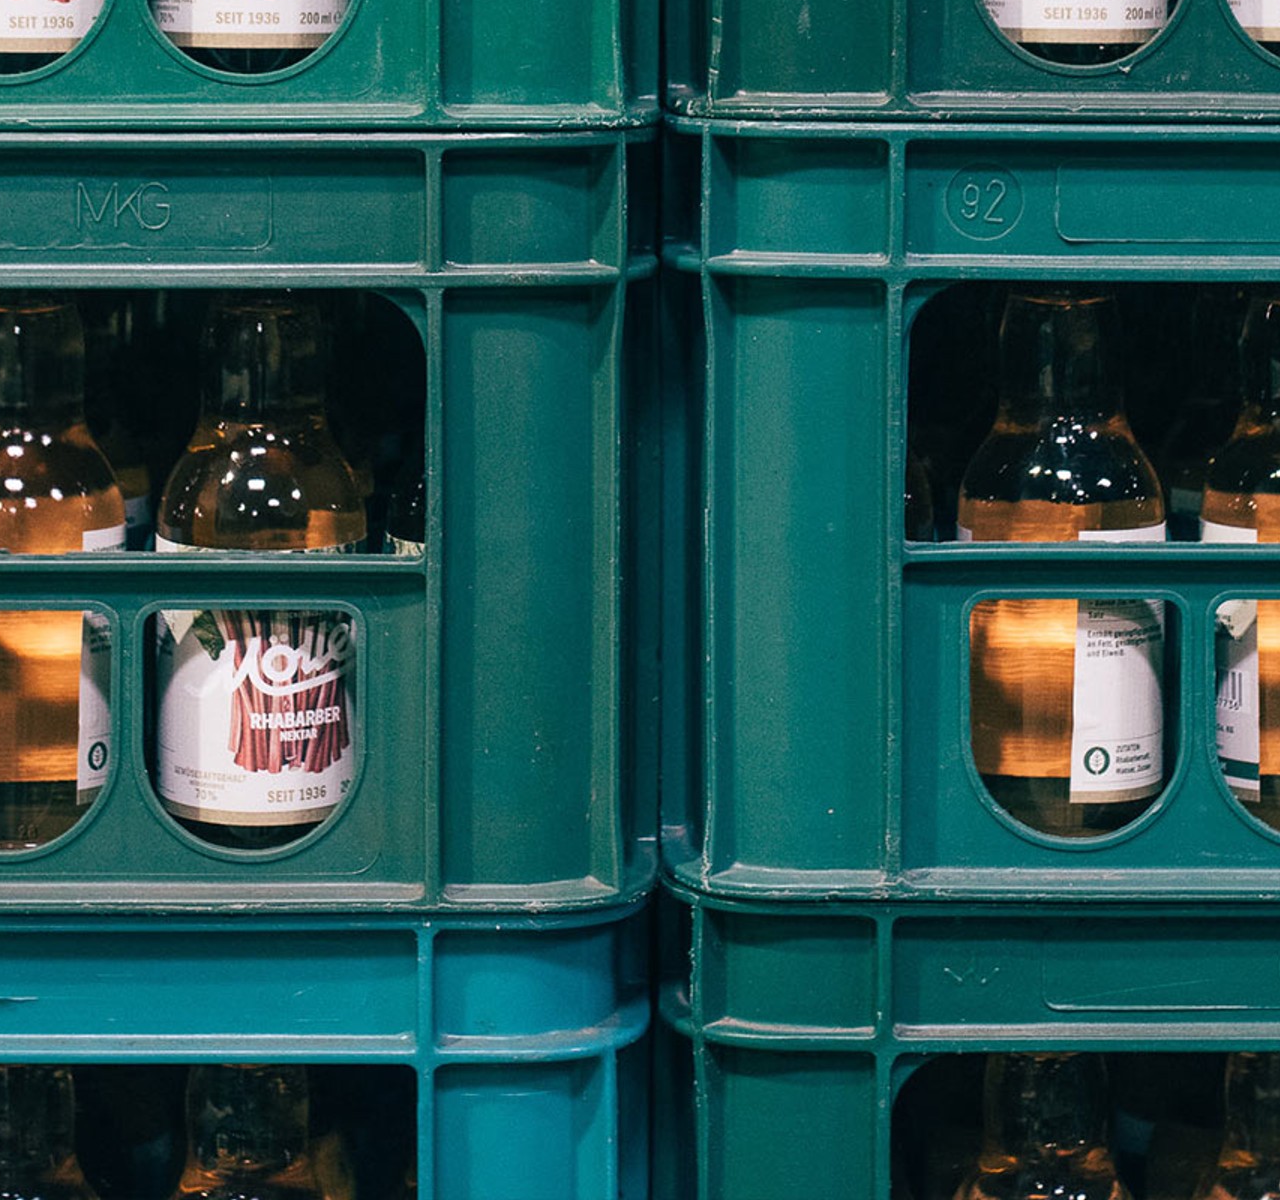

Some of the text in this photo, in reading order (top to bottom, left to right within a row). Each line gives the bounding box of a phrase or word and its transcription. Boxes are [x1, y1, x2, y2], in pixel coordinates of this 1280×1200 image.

[215, 12, 243, 24] SEIT
[248, 12, 280, 24] 1936
[1044, 7, 1071, 19] SEIT
[1077, 7, 1107, 19] 1936
[9, 16, 74, 29] SEIT 1936
[78, 182, 170, 230] MKG
[961, 181, 1006, 222] 92
[249, 706, 341, 729] RHABARBER
[280, 728, 317, 741] NEKTAR
[267, 790, 293, 802] SEIT
[299, 786, 326, 800] 1936
